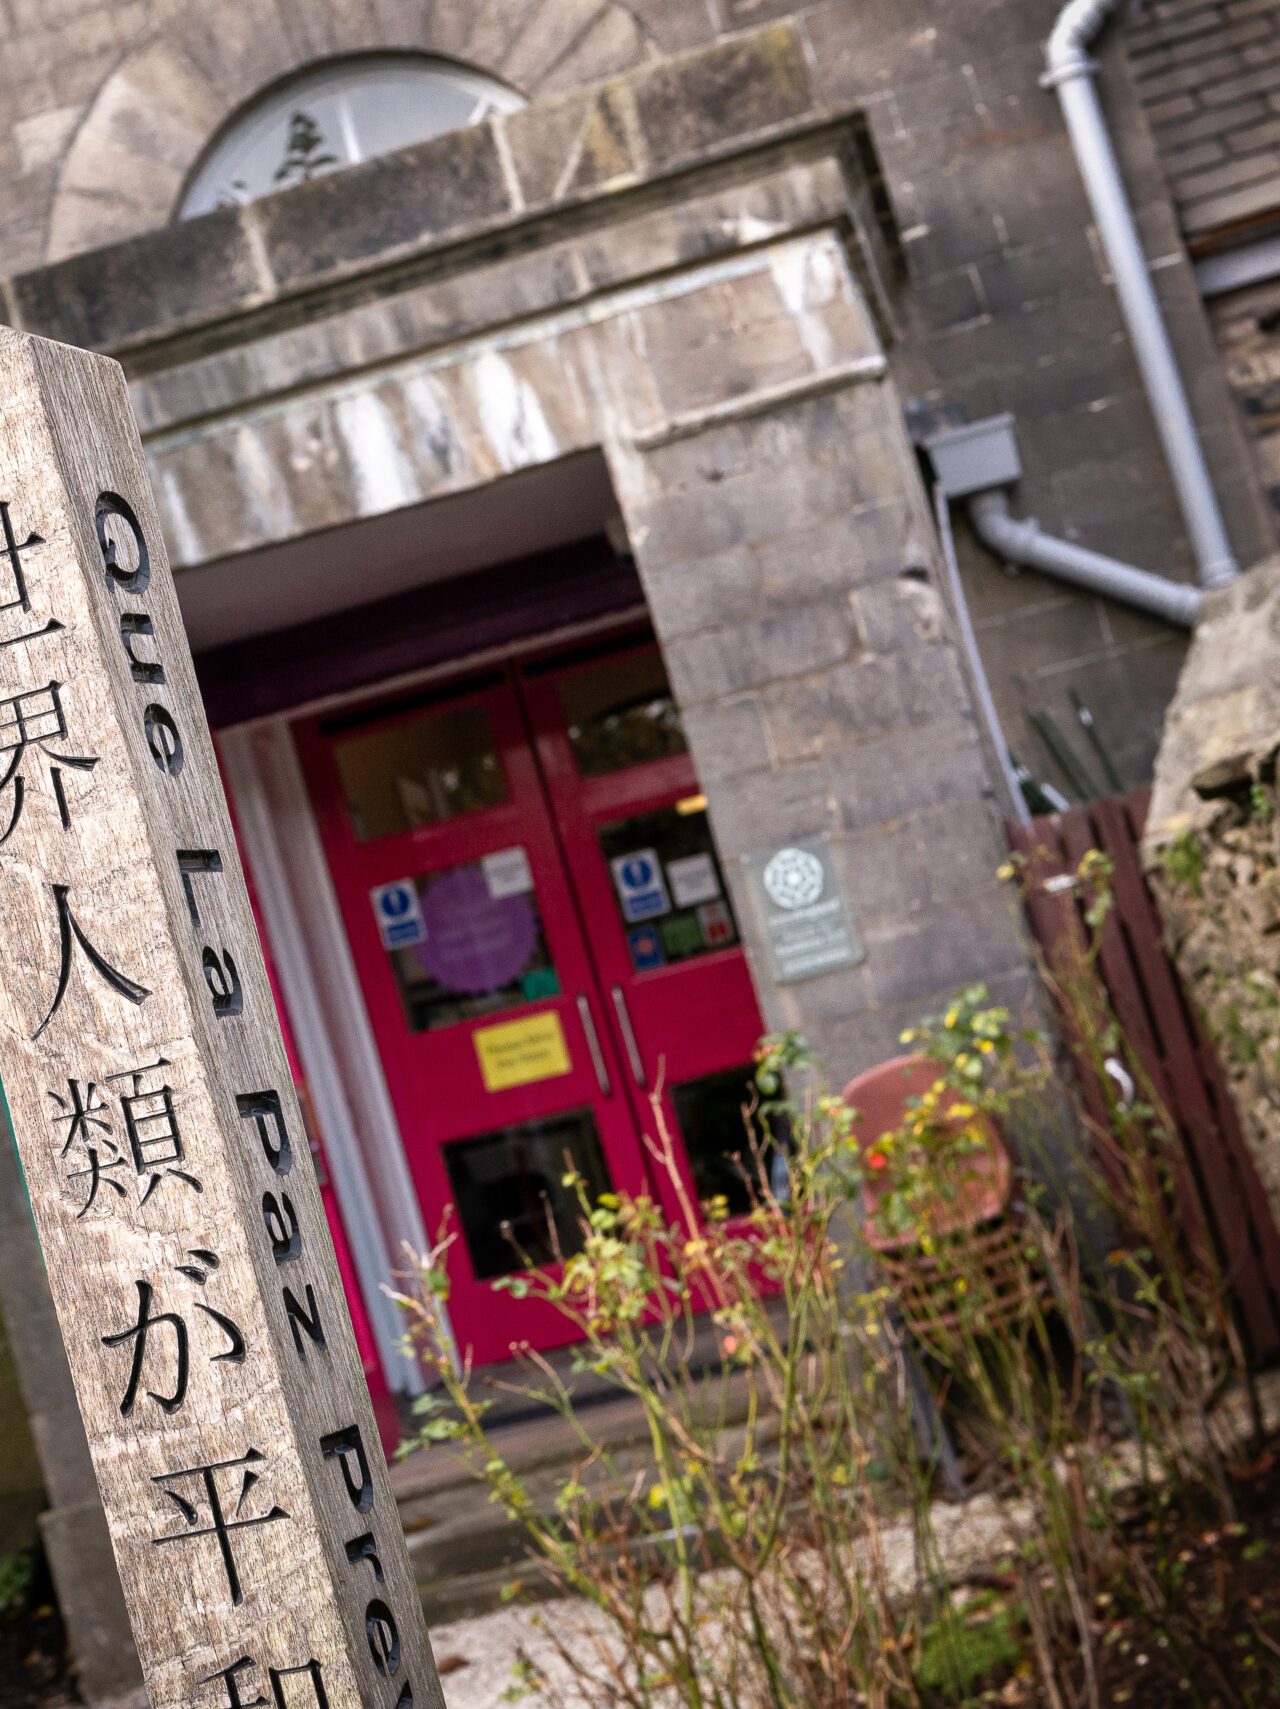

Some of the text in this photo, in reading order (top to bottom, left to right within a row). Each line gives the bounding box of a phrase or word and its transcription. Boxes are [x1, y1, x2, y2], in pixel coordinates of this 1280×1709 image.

[95, 490, 184, 776] Que
[176, 849, 244, 1020] La
[235, 1089, 327, 1362] Paz
